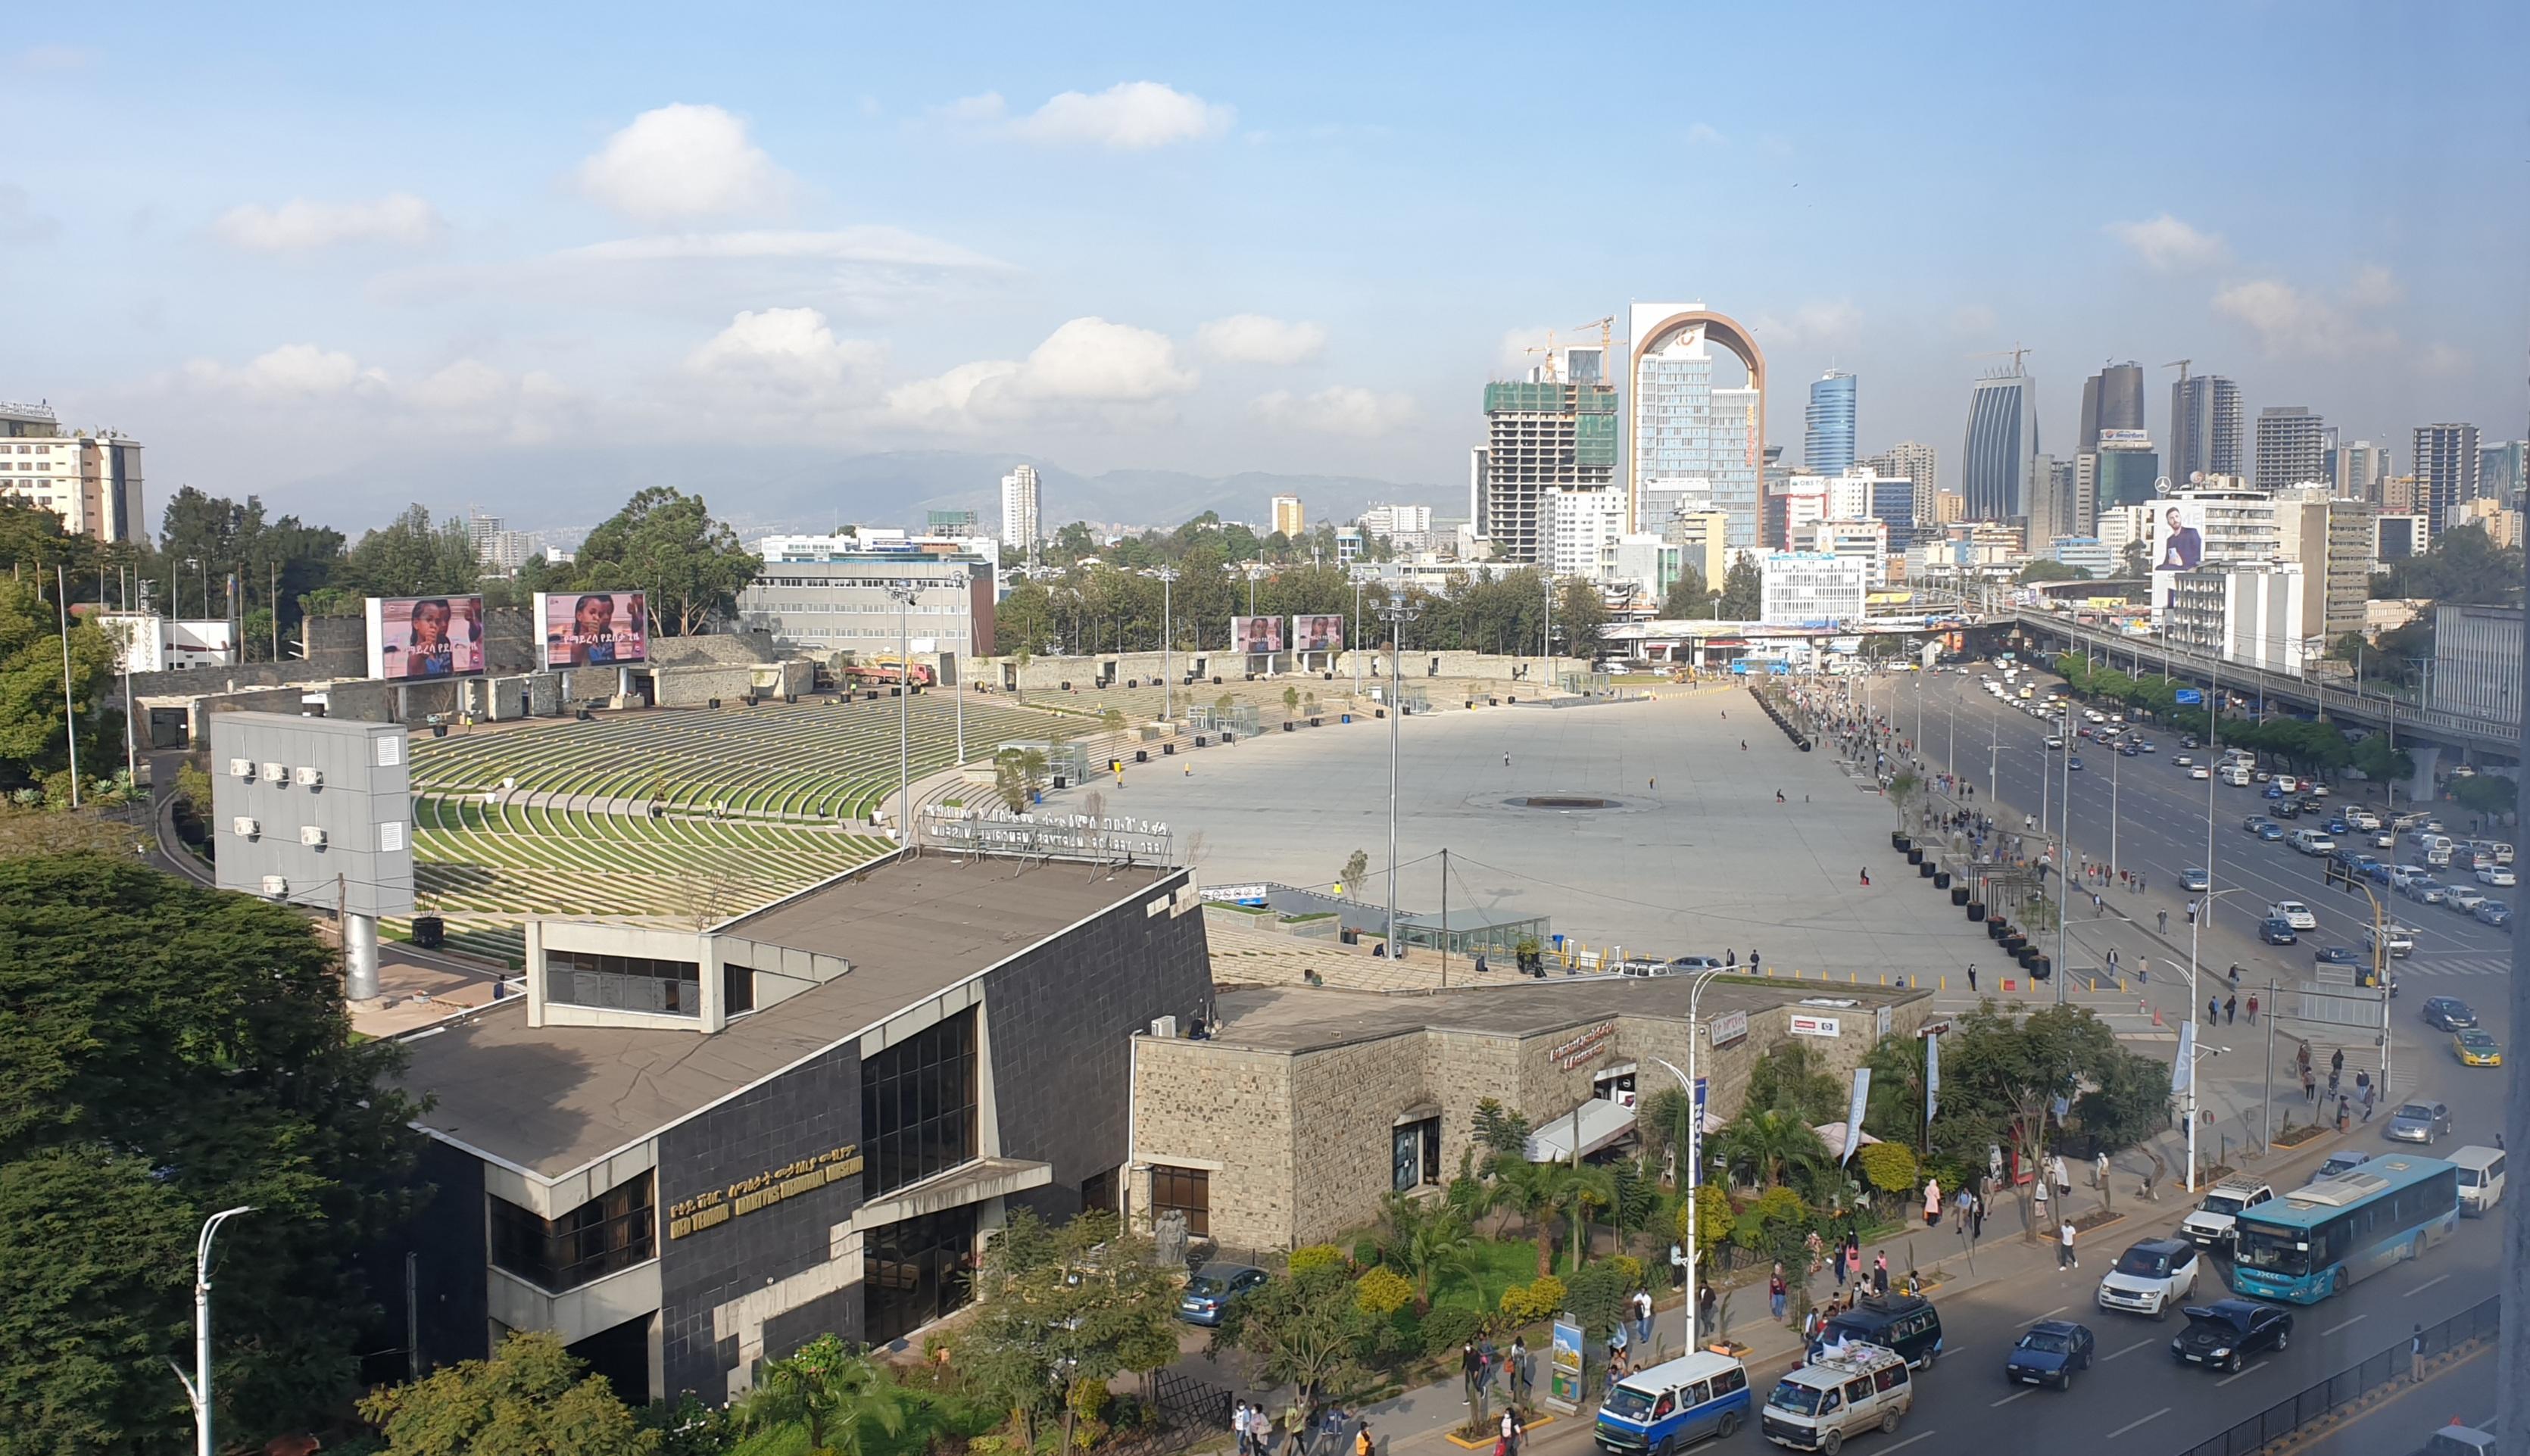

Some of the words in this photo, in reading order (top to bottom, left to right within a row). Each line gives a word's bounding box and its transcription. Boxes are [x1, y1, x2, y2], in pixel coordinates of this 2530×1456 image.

[670, 1216, 691, 1240] RED
[691, 1203, 729, 1232] TERROR
[825, 1155, 864, 1183] MUSEUM
